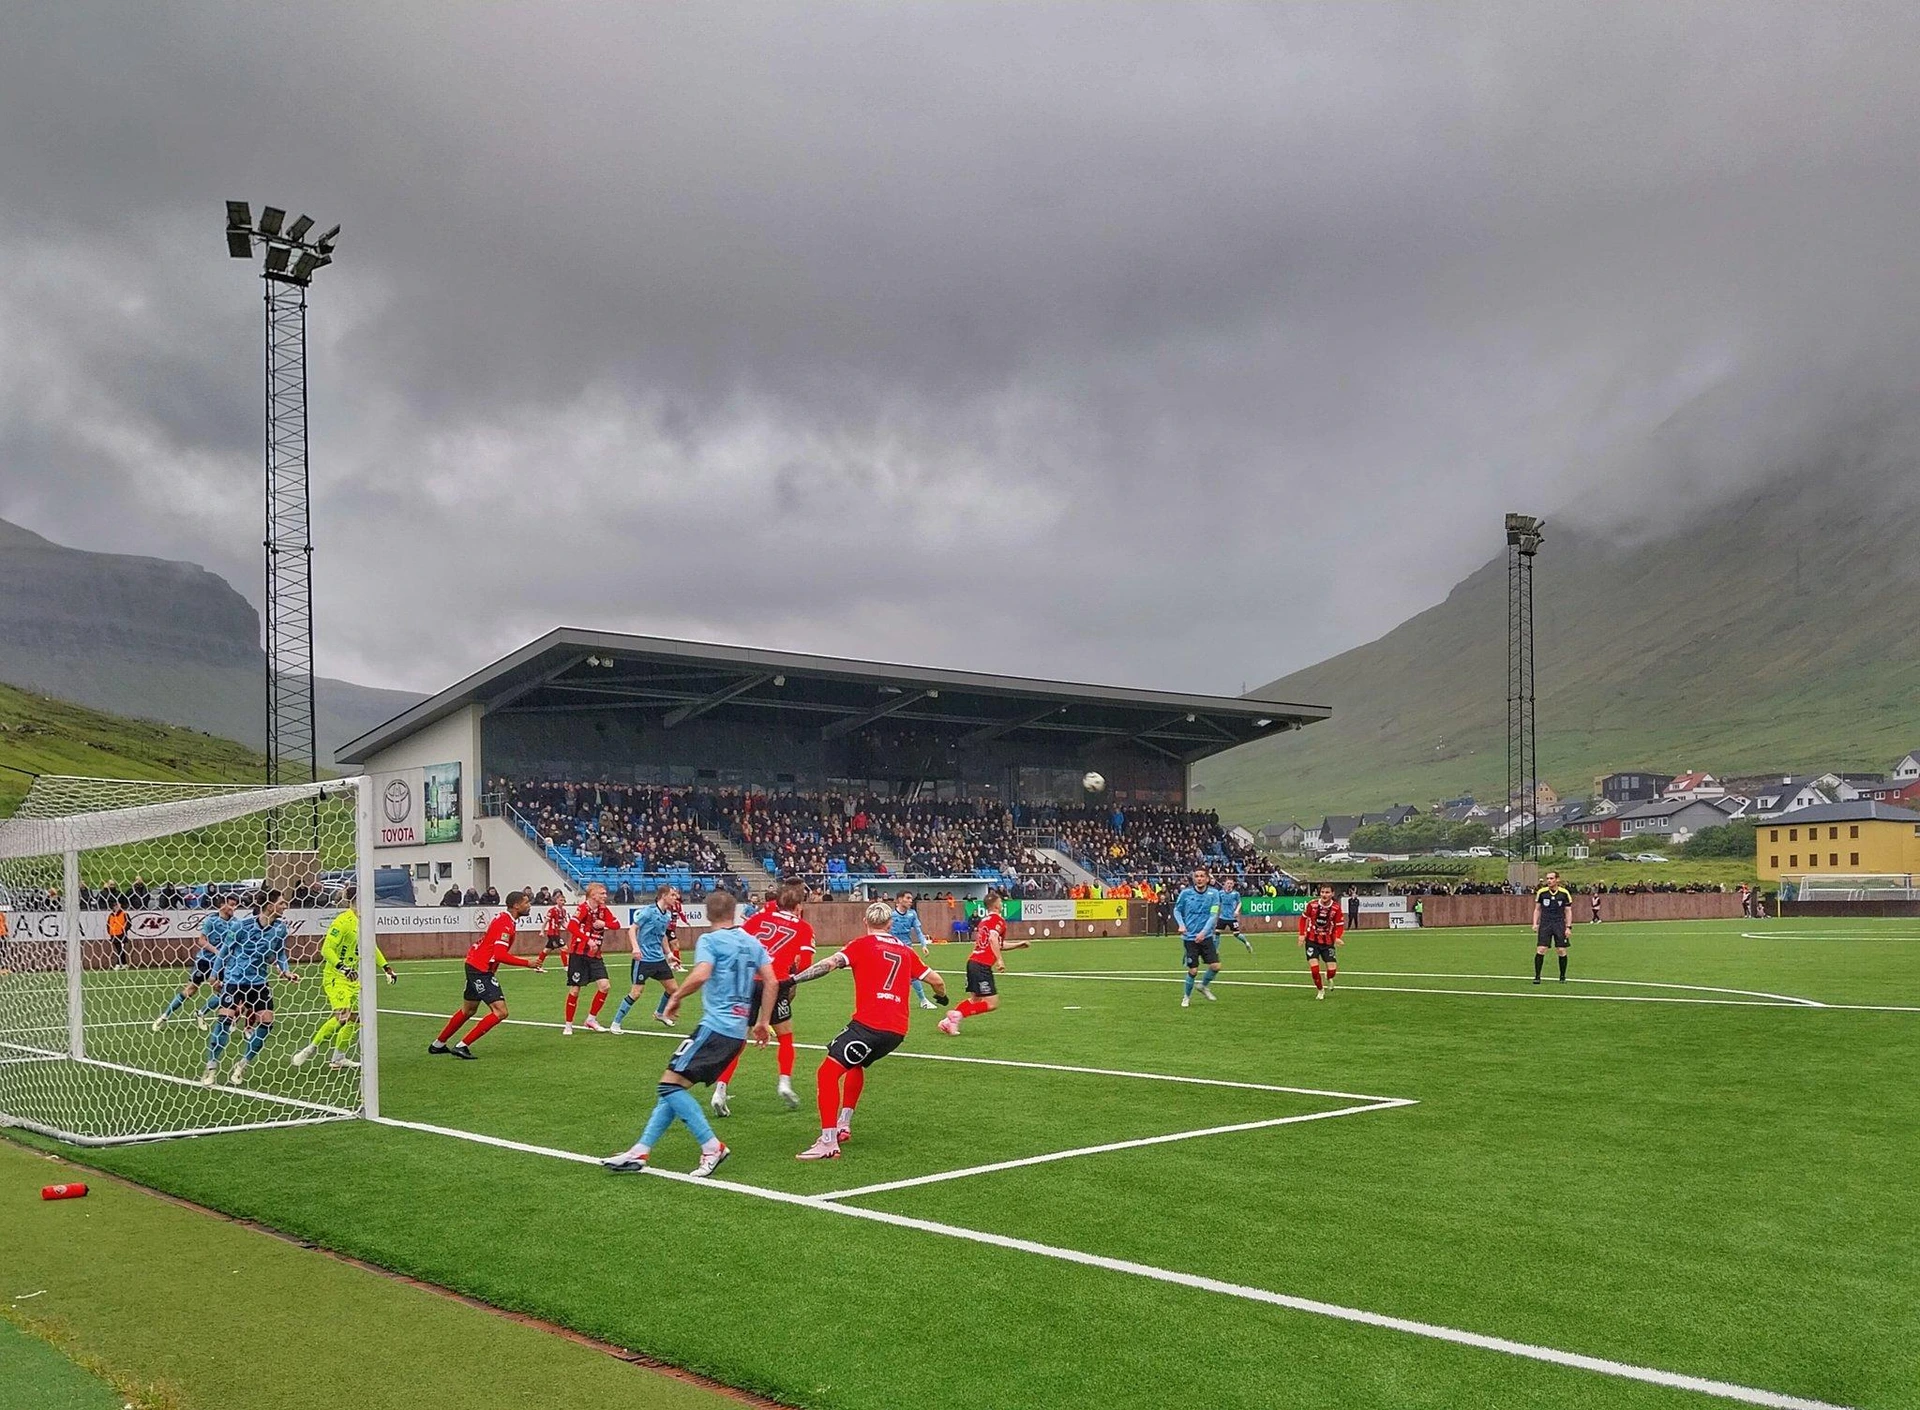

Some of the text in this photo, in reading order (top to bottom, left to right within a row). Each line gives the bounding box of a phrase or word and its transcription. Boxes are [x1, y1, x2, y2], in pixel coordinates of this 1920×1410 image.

[382, 827, 415, 842] TOYOTA
[1024, 903, 1043, 915] KRIS
[1250, 899, 1274, 912] betri
[1293, 899, 1308, 912] bet
[401, 915, 411, 926] til
[412, 914, 441, 927] dystin
[755, 920, 797, 956] 27
[883, 950, 902, 991] 7
